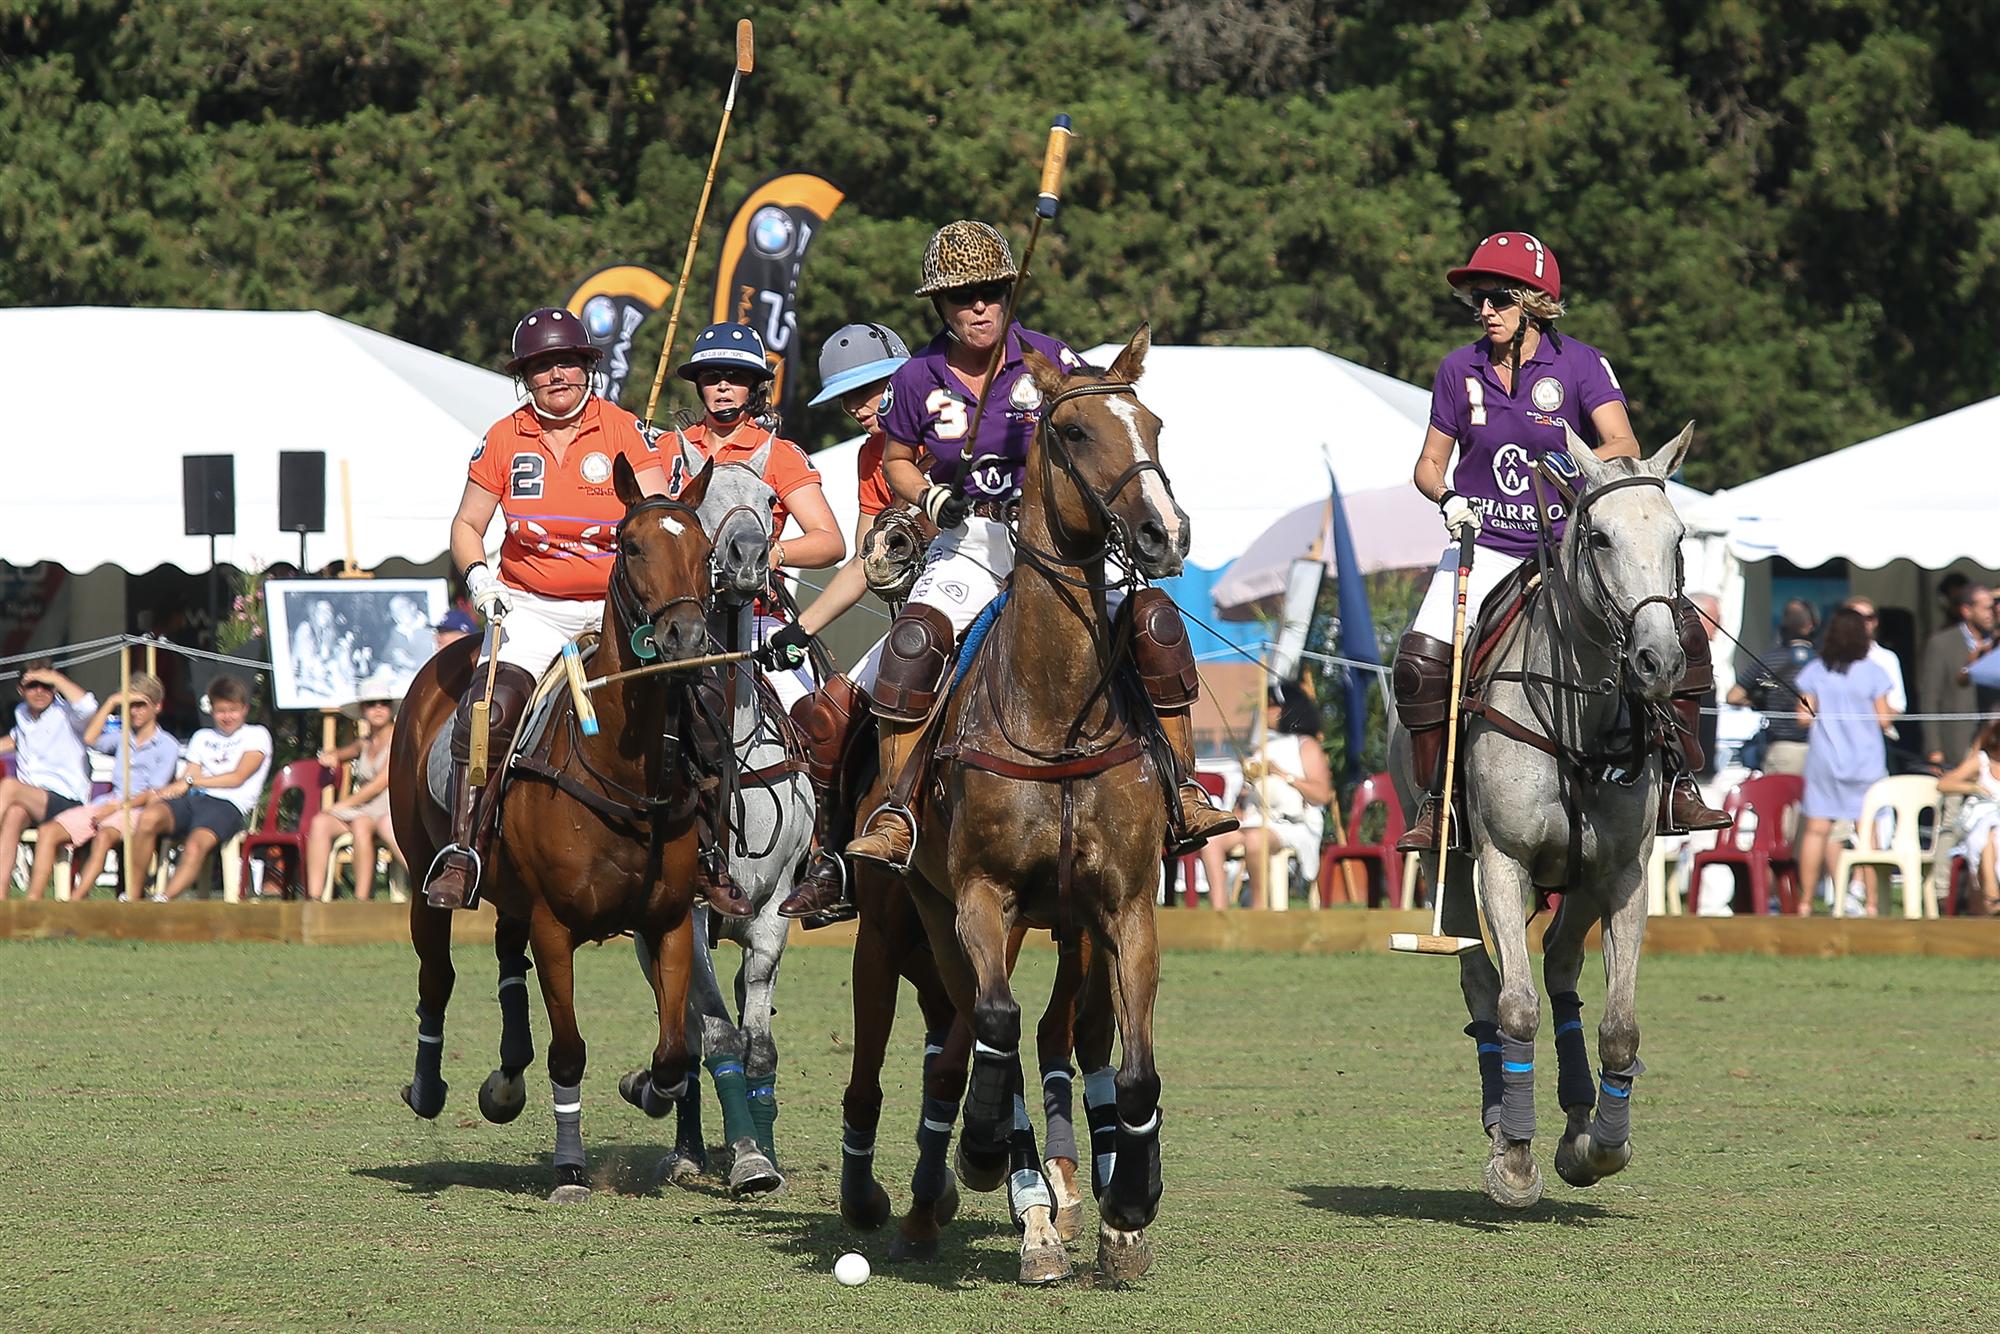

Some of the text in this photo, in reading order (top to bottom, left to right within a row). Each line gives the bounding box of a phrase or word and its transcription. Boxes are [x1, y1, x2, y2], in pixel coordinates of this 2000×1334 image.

[925, 388, 969, 440] 3
[1465, 377, 1488, 426] 1
[511, 452, 545, 499] 2
[669, 455, 684, 497] 1
